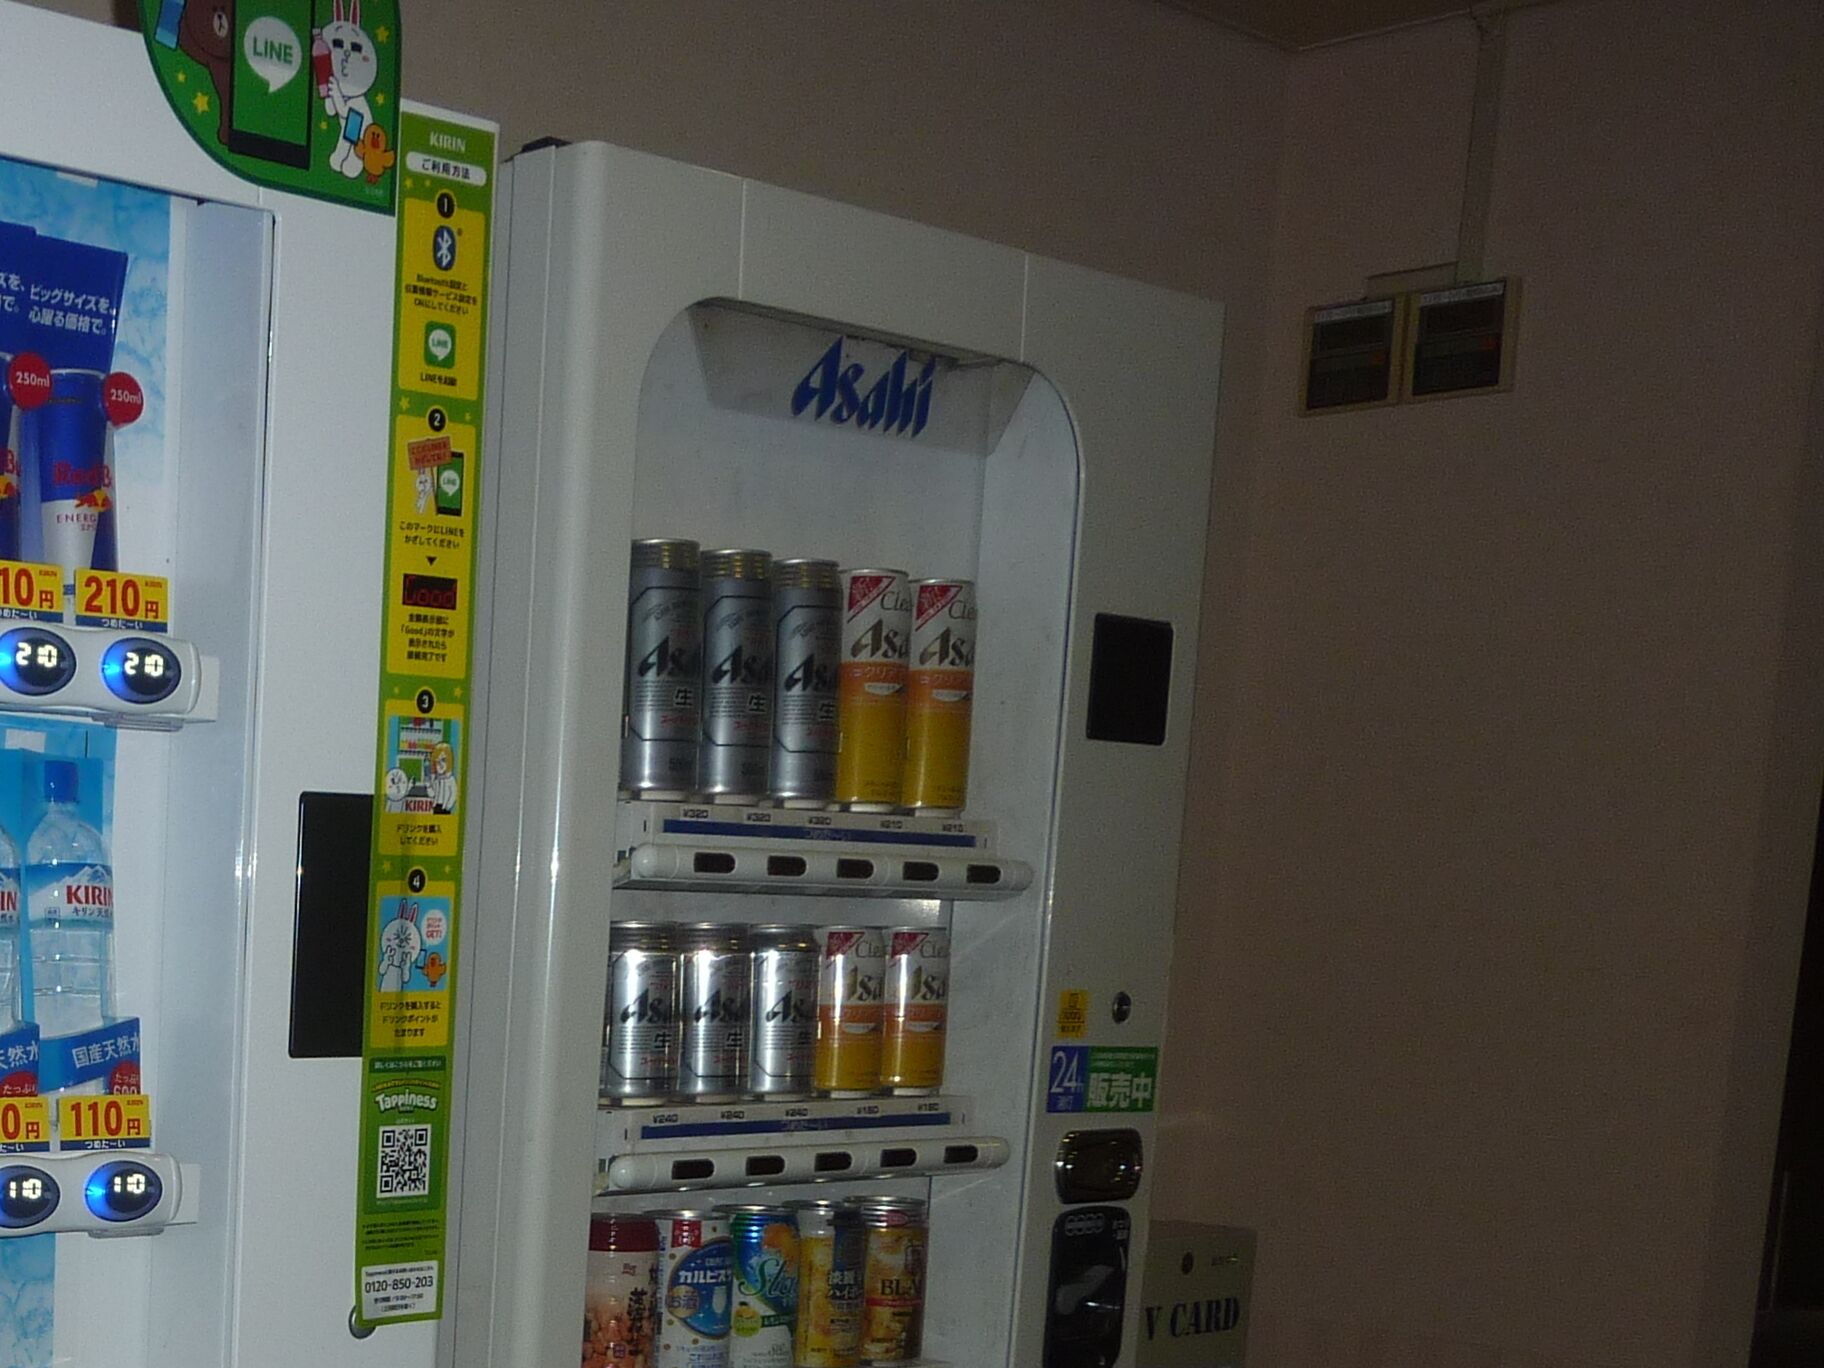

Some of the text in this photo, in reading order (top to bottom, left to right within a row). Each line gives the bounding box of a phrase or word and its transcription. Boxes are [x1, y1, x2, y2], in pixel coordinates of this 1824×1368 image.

[253, 36, 295, 66] LINE
[430, 131, 467, 152] KIRIN
[421, 158, 471, 181] ご利用方法
[15, 371, 50, 388] 250ml
[790, 335, 937, 439] Asahi
[16, 642, 57, 668] 210
[682, 809, 710, 821] ¥320
[746, 813, 773, 824] ¥320
[375, 1089, 438, 1112] Tappiness
[1086, 1071, 1155, 1110] 販売中
[652, 1112, 679, 1125] ¥240
[9, 1178, 42, 1199] 110
[114, 1173, 145, 1194] 110
[364, 1275, 434, 1294] 0120-850-203
[1169, 1297, 1241, 1339] CARD
